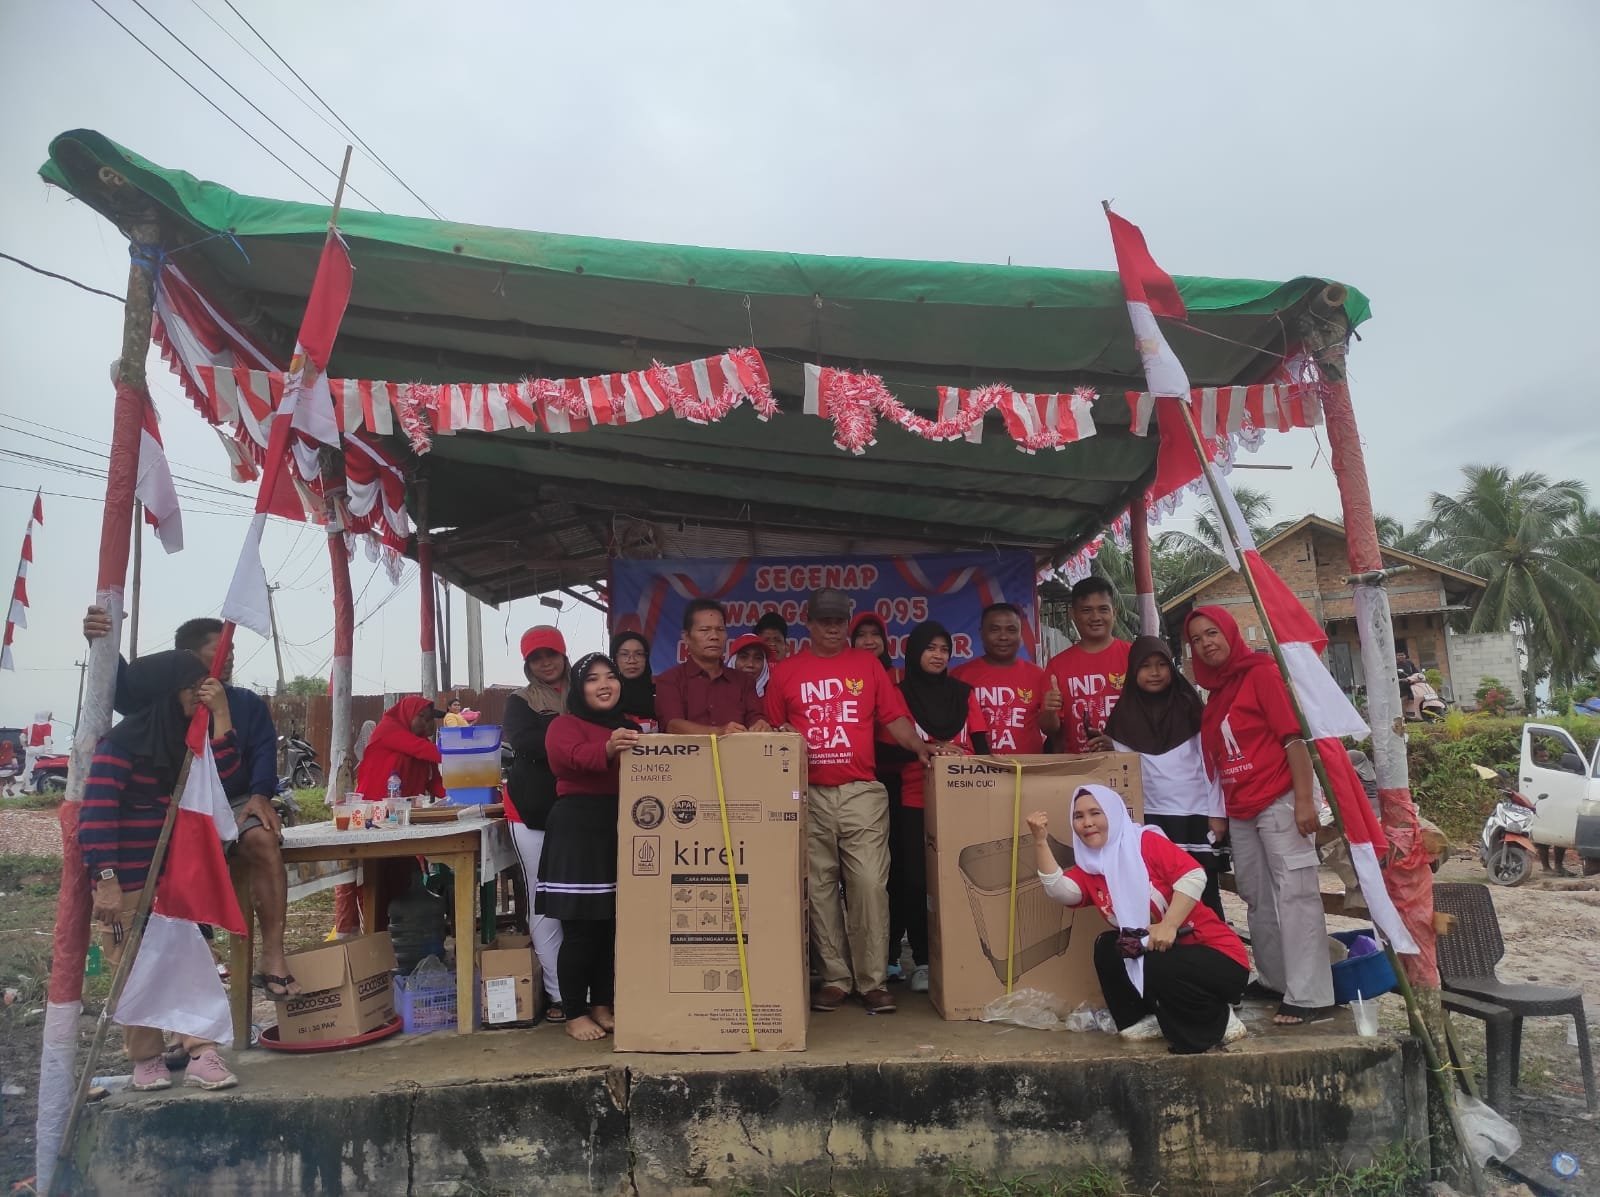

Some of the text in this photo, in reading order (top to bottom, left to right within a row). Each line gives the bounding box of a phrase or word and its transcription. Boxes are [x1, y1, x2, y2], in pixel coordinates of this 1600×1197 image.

[756, 565, 878, 591] SEGENAP
[875, 597, 929, 624] 095
[801, 678, 844, 703] IND
[631, 744, 700, 756] SHARP
[631, 763, 671, 773] SJ-N162
[947, 779, 996, 788] MESIN CUCI
[674, 840, 745, 866] kirei
